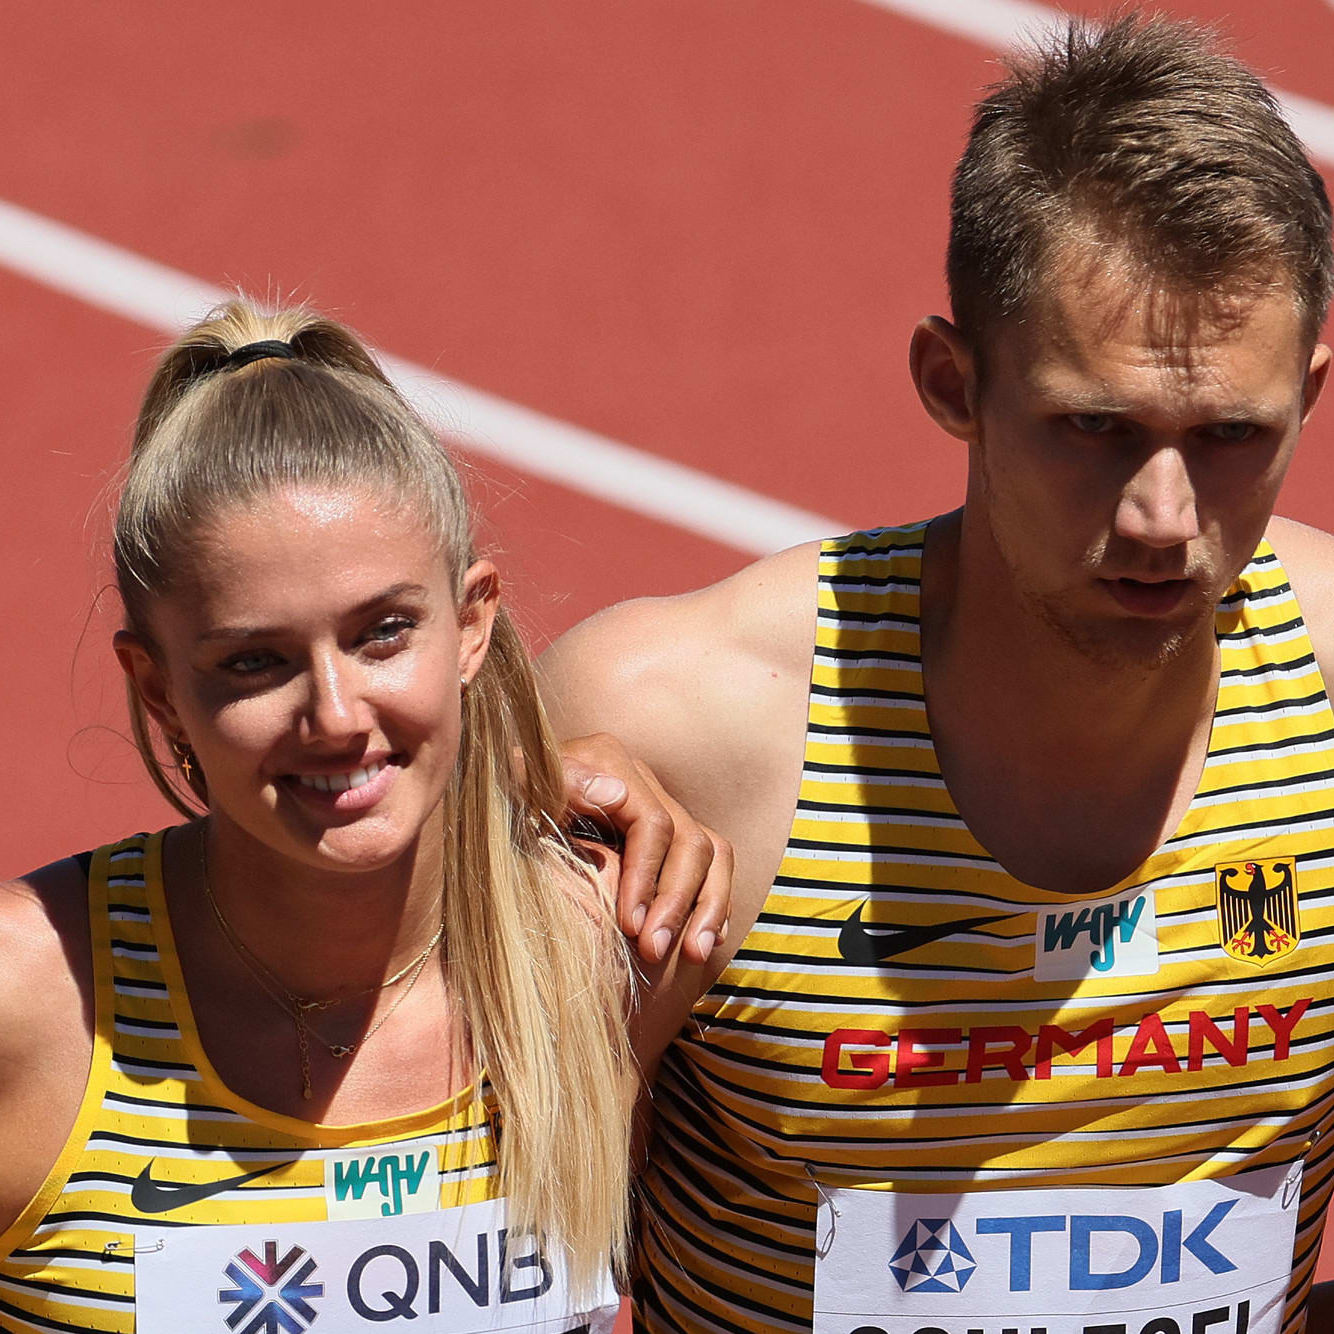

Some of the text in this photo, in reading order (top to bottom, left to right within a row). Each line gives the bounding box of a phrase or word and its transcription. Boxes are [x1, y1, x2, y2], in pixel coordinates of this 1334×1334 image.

[820, 997, 1315, 1091] GERMANY
[346, 1227, 554, 1323] QNB
[975, 1197, 1241, 1293] TDK
